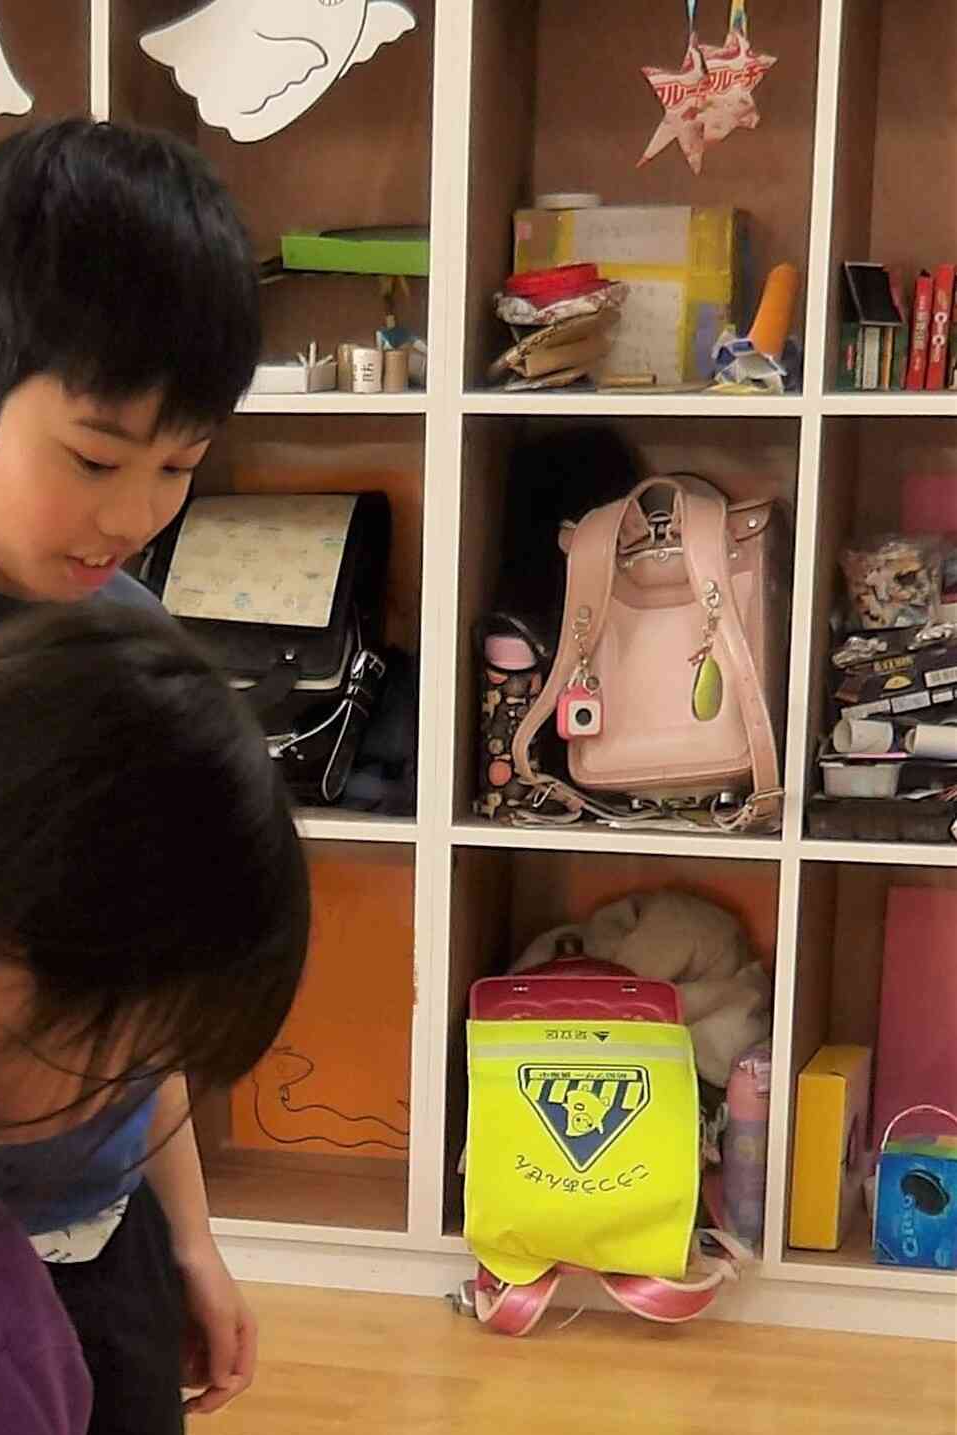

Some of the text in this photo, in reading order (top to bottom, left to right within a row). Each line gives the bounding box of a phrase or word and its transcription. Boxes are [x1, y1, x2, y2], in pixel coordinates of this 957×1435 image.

[515, 1154, 649, 1194] こうつうあんぜん
